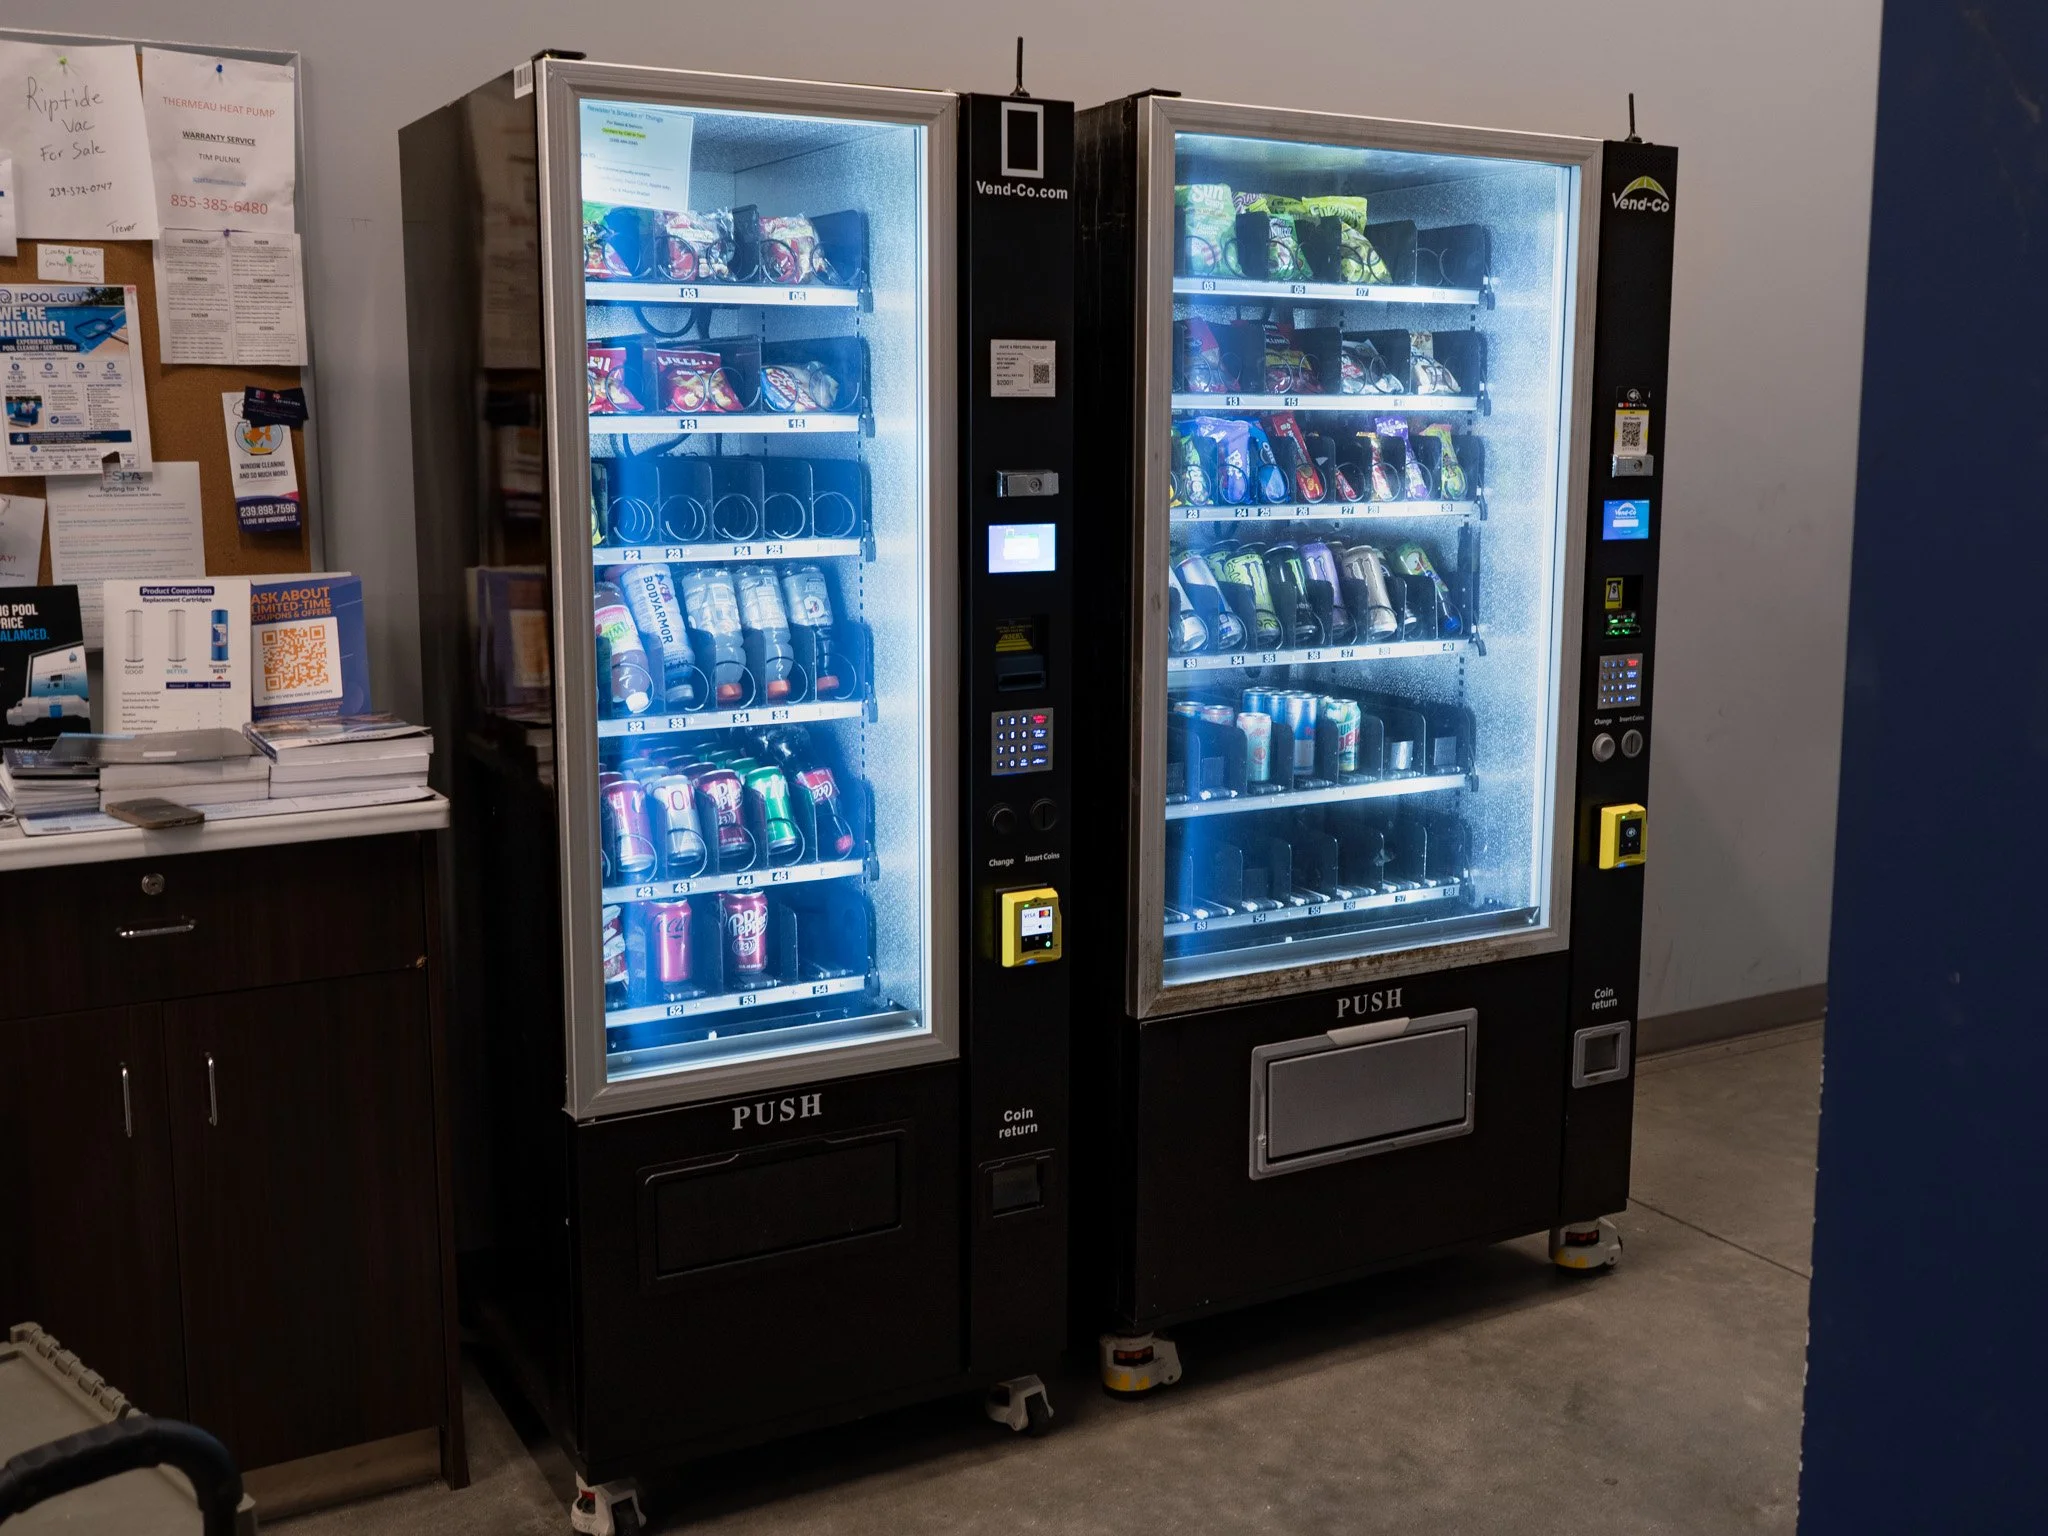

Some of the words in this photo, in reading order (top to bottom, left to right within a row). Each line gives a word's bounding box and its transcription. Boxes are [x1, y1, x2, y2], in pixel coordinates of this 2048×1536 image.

[27, 76, 104, 121] Riptide
[162, 96, 218, 111] THERMEAU
[220, 104, 244, 114] HEAT
[246, 107, 276, 118] PUMP
[62, 119, 95, 133] Vac
[182, 130, 225, 144] WARRANTY
[226, 135, 256, 146] SERVICE
[40, 144, 63, 161] For
[72, 140, 106, 160] Sale
[199, 153, 213, 161] TIM
[214, 154, 241, 164] PULNIK
[976, 180, 1068, 199] Vend-Co.com
[170, 194, 268, 215] 855-385-6480
[1612, 192, 1670, 212] Vend-Co
[106, 220, 137, 234] Trevor
[682, 288, 697, 298] 03
[1203, 281, 1215, 291] 03
[1293, 285, 1305, 294] 05
[1357, 288, 1369, 296] 07
[20, 292, 85, 303] POOLGUY
[0, 306, 47, 320] WE'RE
[0, 320, 66, 337] HIRING!
[1228, 397, 1239, 406] 13
[682, 419, 696, 429] 13
[240, 462, 261, 470] WINDOW
[261, 461, 286, 469] CLEANING
[240, 503, 297, 517] 239.898.7596
[1188, 510, 1199, 519] 23
[1236, 509, 1248, 517] 24
[1259, 508, 1270, 517] 25
[1298, 507, 1309, 515] 26
[625, 550, 640, 560] 22
[667, 549, 682, 558] 23
[735, 546, 749, 555] 24
[170, 588, 212, 596] Comparison
[251, 591, 279, 605] ASK
[281, 586, 330, 602] ABOUT
[12, 603, 39, 616] POOL
[251, 598, 331, 614] LIMITED-TIME
[643, 575, 674, 645] BODYARMOR
[252, 611, 292, 621] COUPONS
[301, 608, 331, 617] OFFERS
[0, 617, 24, 630] RICE
[0, 628, 50, 642] ALANCED.
[1186, 659, 1197, 668] 33
[1232, 656, 1243, 665] 34
[1264, 654, 1275, 662] 35
[629, 721, 644, 731] 32
[671, 718, 685, 728] 33
[734, 713, 748, 723] 34
[1594, 718, 1612, 726] Change
[989, 858, 1015, 867] Change
[1025, 854, 1042, 862] Insert
[1043, 852, 1060, 860] Coins
[637, 887, 652, 897] 42
[675, 883, 689, 893] 43
[738, 876, 752, 885] 44
[1196, 921, 1207, 930] 53
[1594, 986, 1614, 1000] Coin
[669, 1005, 683, 1016] 52
[742, 995, 756, 1005] 53
[1336, 986, 1403, 1018] PUSH
[1592, 998, 1618, 1011] return
[731, 1092, 823, 1132] PUSH
[1003, 1107, 1034, 1123] Coin
[998, 1121, 1038, 1140] return
